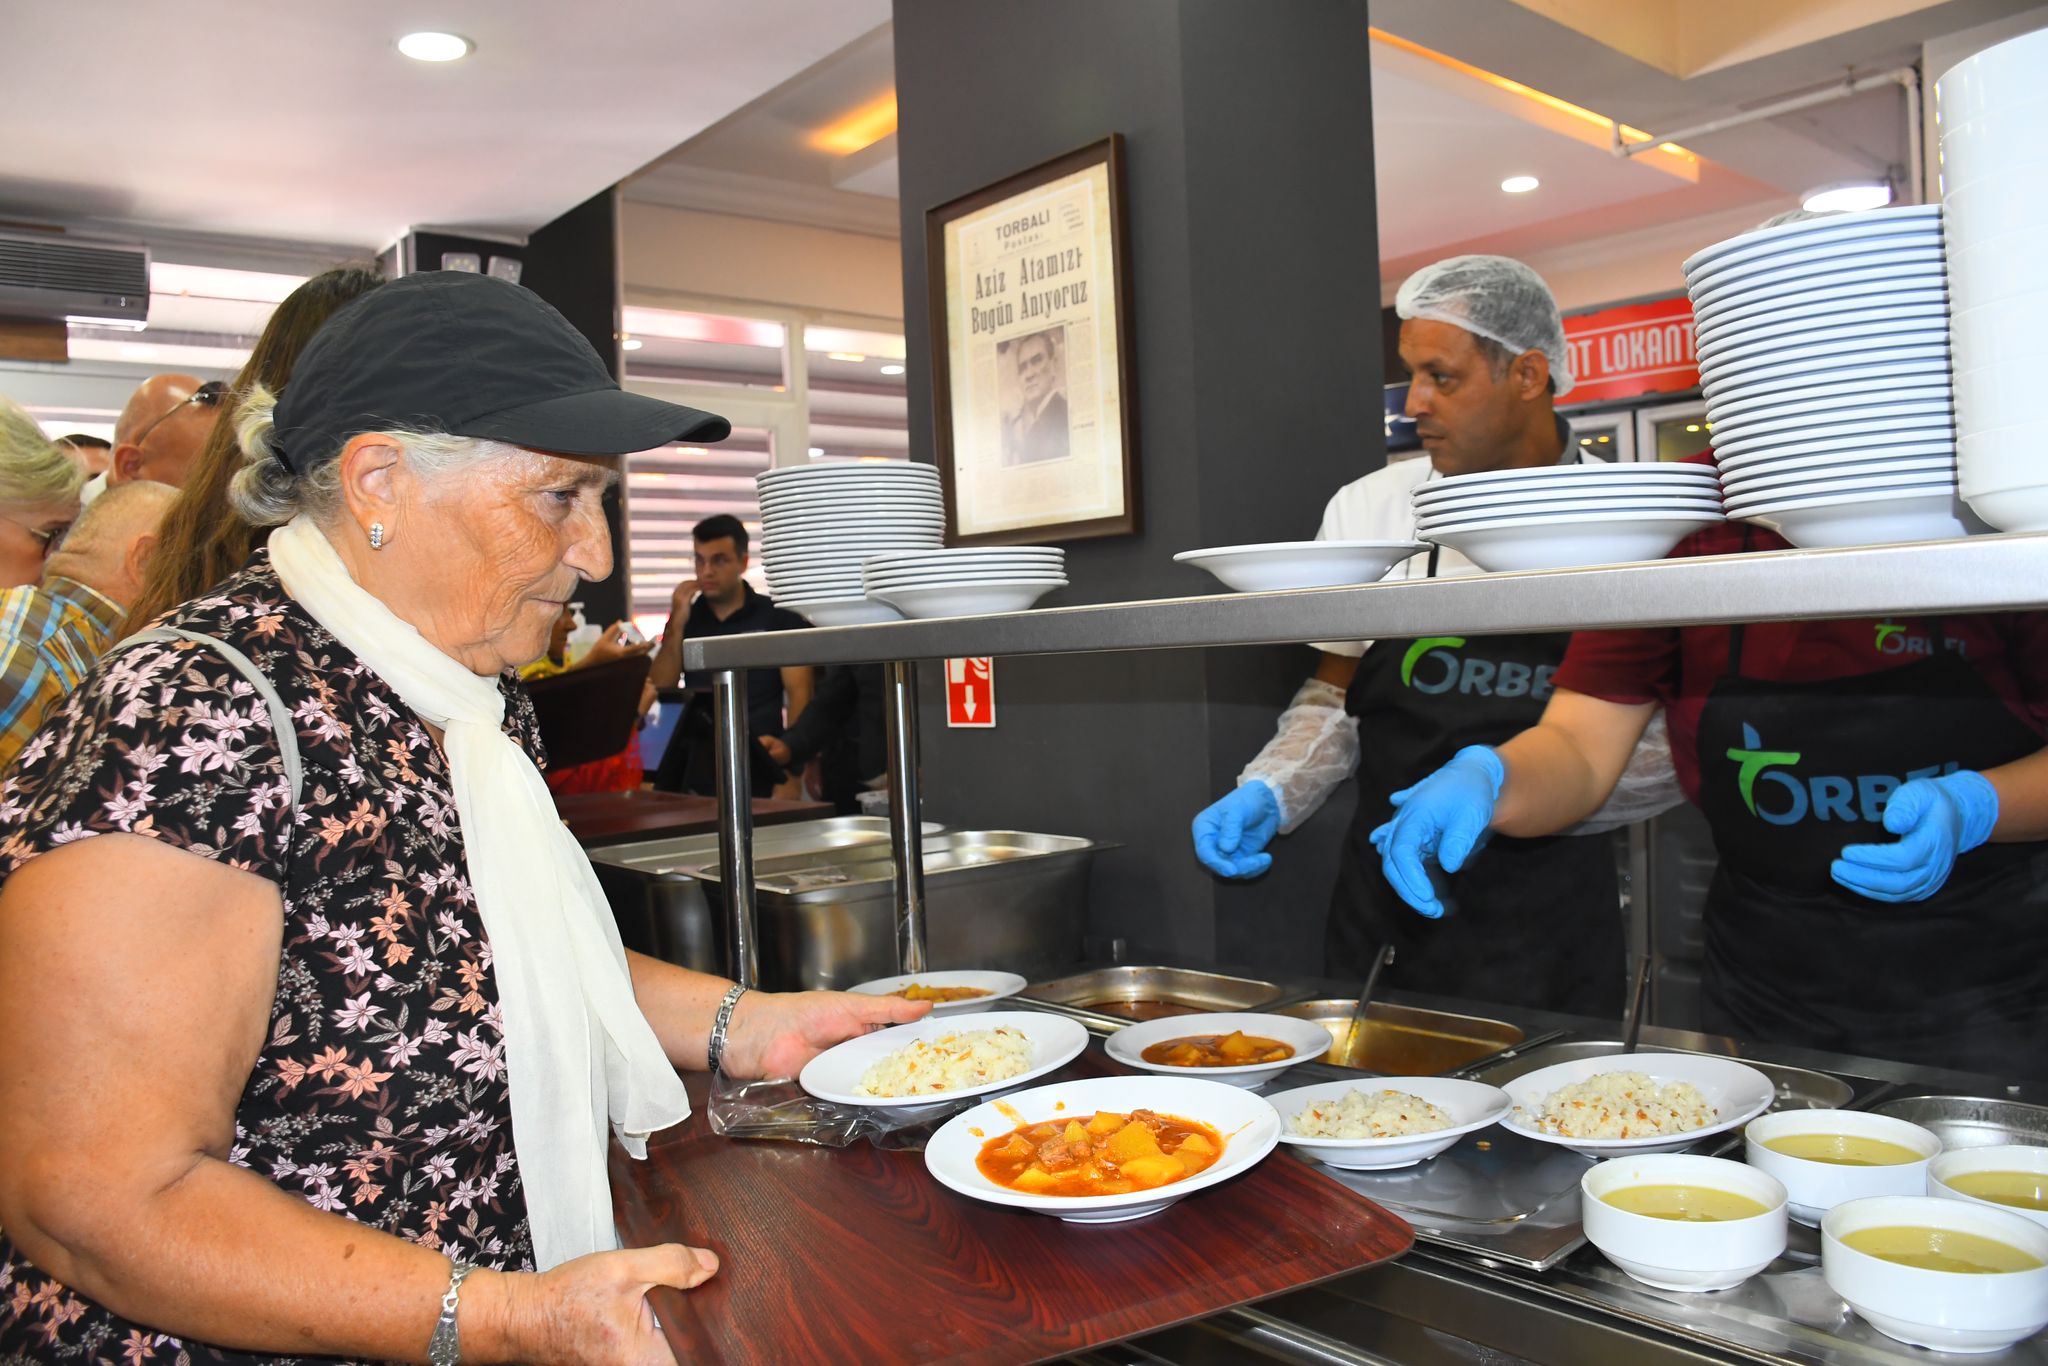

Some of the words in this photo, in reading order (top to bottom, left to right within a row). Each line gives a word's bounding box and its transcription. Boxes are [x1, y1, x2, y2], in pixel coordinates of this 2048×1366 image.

[995, 208, 1050, 241] TORBALI
[975, 267, 1006, 301] Aziz
[971, 300, 1014, 335] Bugün
[1020, 280, 1088, 320] Anıyoruz
